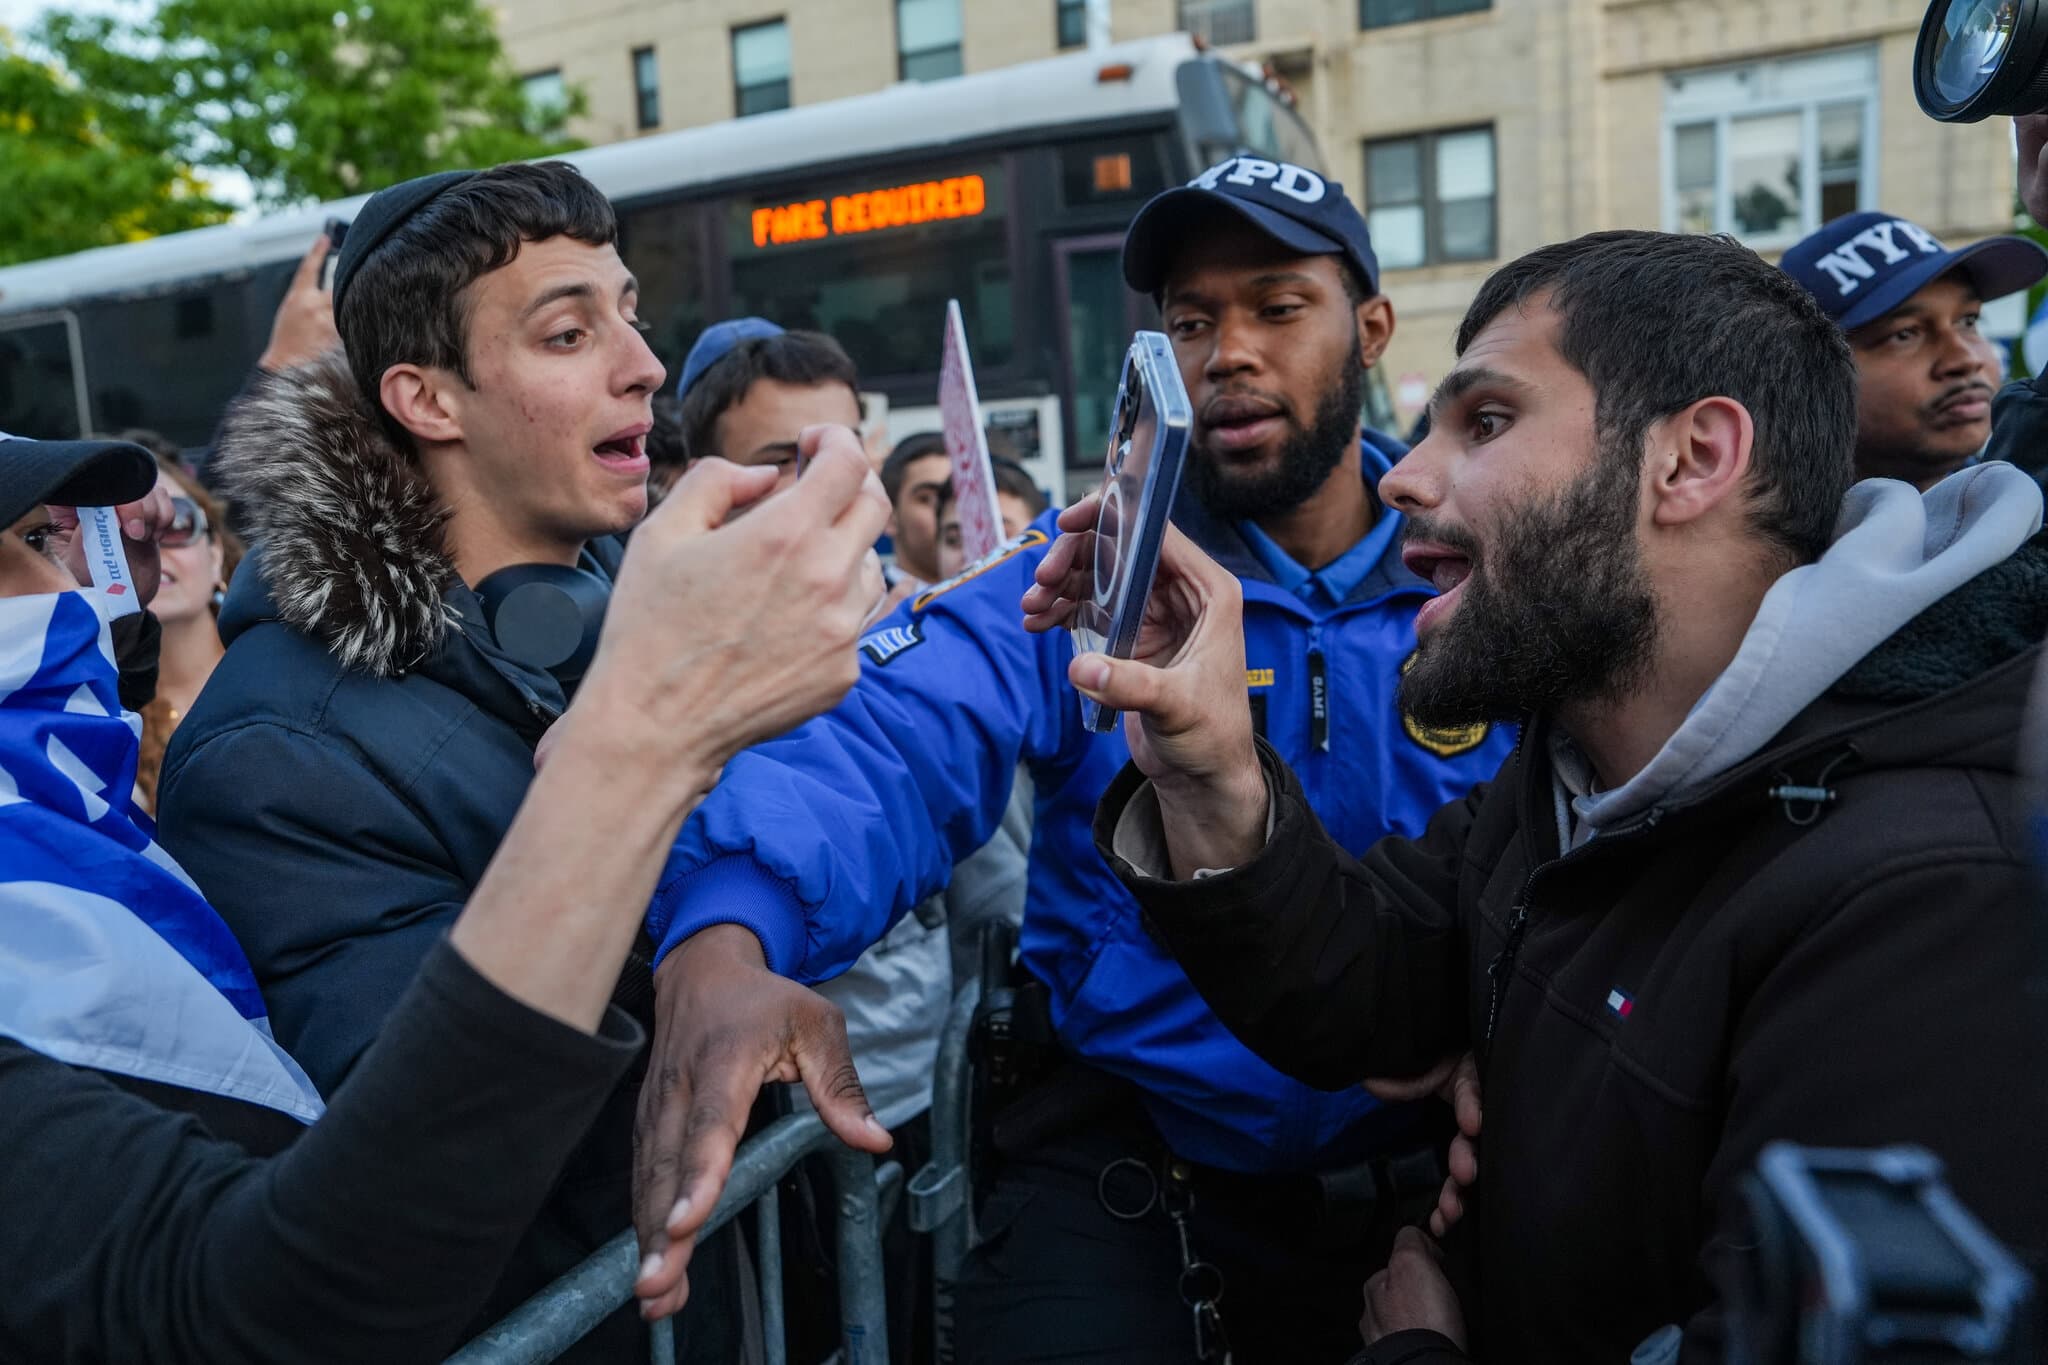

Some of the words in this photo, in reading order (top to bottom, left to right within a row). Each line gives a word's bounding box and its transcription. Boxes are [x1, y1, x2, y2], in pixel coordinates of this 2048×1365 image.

[752, 200, 828, 247] FARE
[831, 174, 985, 235] REQUIRED
[1186, 157, 1326, 203] YPD
[1815, 220, 1938, 296] NYP
